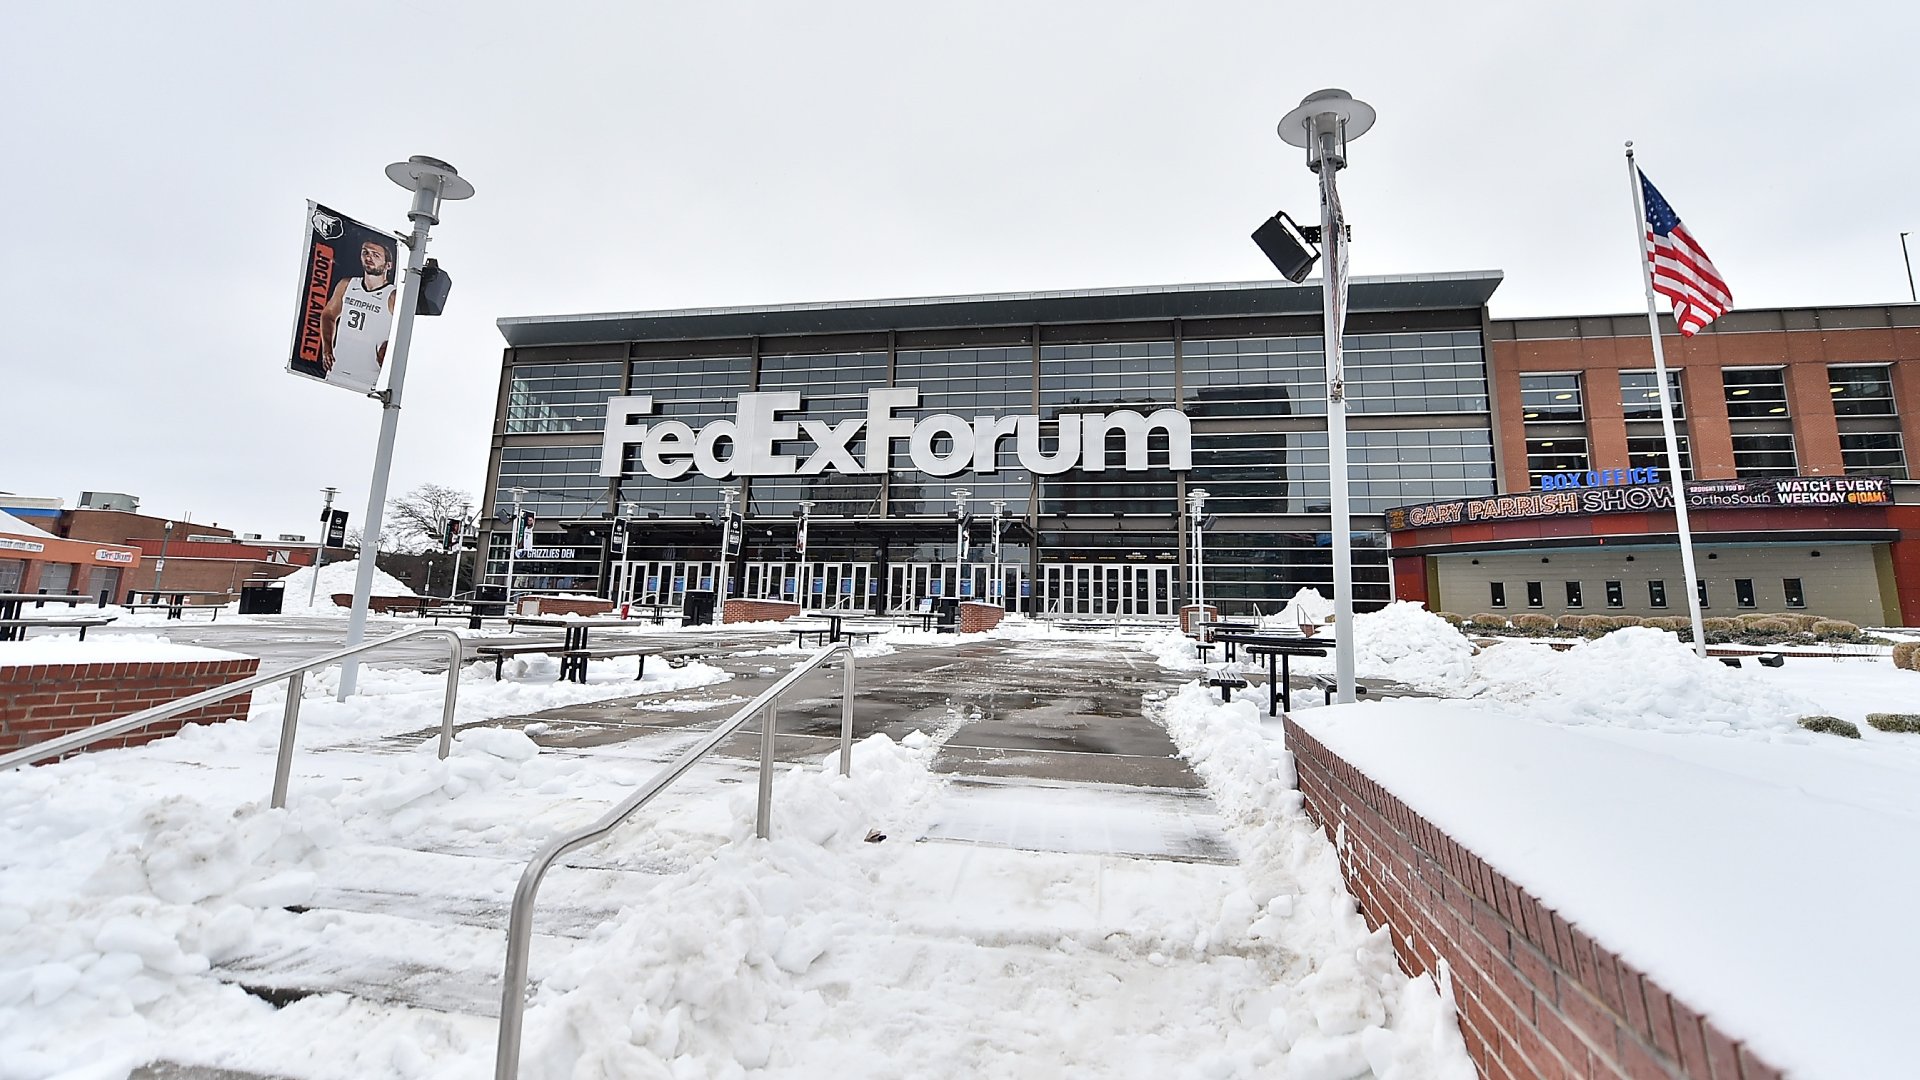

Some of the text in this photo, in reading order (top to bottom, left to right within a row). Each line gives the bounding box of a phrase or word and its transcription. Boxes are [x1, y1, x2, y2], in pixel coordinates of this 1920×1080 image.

[302, 249, 331, 357] JOCK LANDALE
[344, 296, 382, 315] MEMPHIS
[347, 309, 366, 331] 31
[599, 386, 1193, 481] FedExForum
[1541, 466, 1660, 492] BOX OFFICE
[1776, 480, 1883, 492] WATCH EVERY
[1409, 503, 1463, 527] GARY
[1468, 492, 1579, 520] PARRISH
[1583, 486, 1676, 512] SHOW
[1691, 492, 1771, 506] OrthoSouth
[1777, 492, 1847, 504] WEEKDAY
[527, 549, 575, 558] GRIZZLIES DEN
